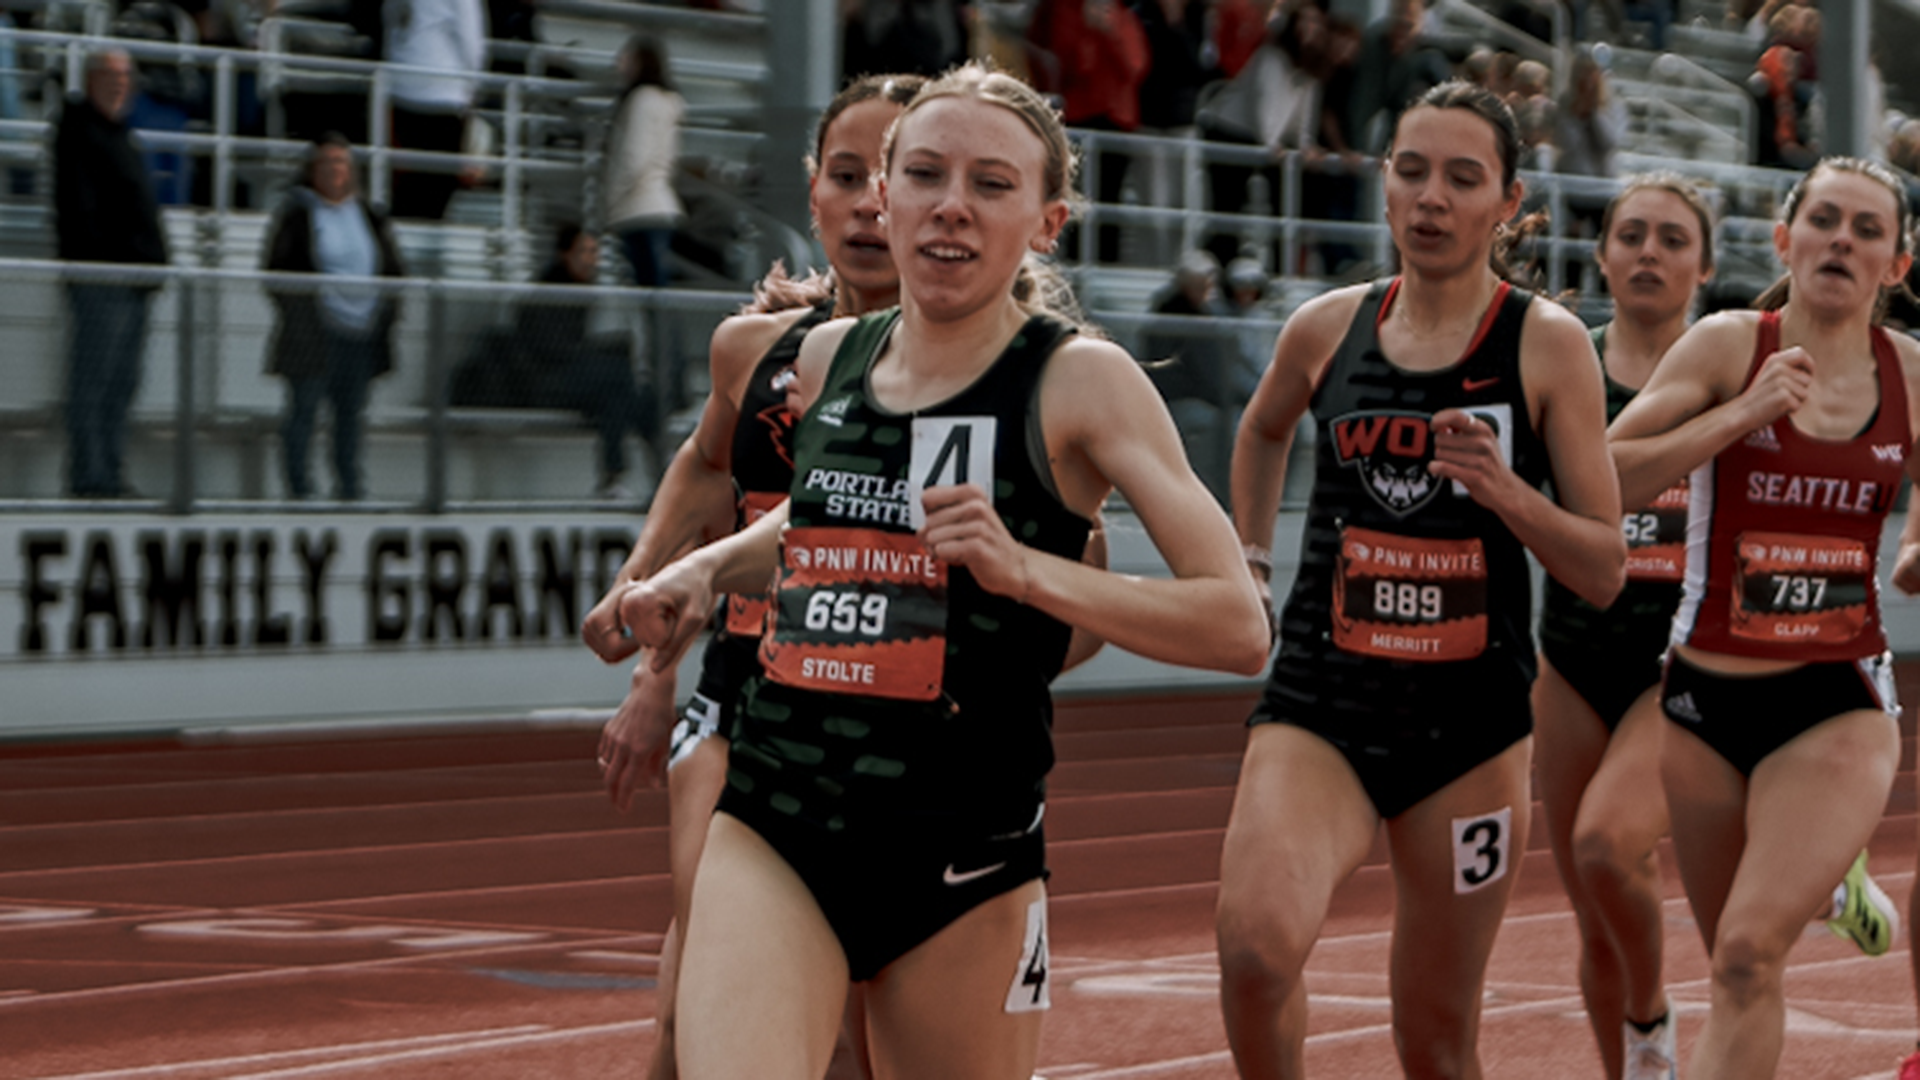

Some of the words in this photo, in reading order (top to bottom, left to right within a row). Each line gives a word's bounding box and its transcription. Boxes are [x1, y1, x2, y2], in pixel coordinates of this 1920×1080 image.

[1336, 415, 1430, 460] WO
[805, 468, 910, 502] PORTLA
[826, 495, 912, 527] STATE
[1623, 513, 1659, 541] 52
[814, 546, 858, 571] PNW
[863, 548, 937, 579] INVITE
[1373, 546, 1414, 568] PNW
[1419, 551, 1481, 571] INVITE
[1770, 545, 1807, 564] PNW
[1811, 548, 1863, 567] INVITE
[18, 527, 340, 653] FAMILY
[1374, 580, 1442, 619] 889
[1772, 575, 1827, 607] 737
[805, 590, 889, 637] 659
[1370, 632, 1441, 653] MERRITT
[802, 657, 875, 684] STOLTE
[1461, 818, 1501, 885] 3
[1021, 918, 1046, 1004] 4
